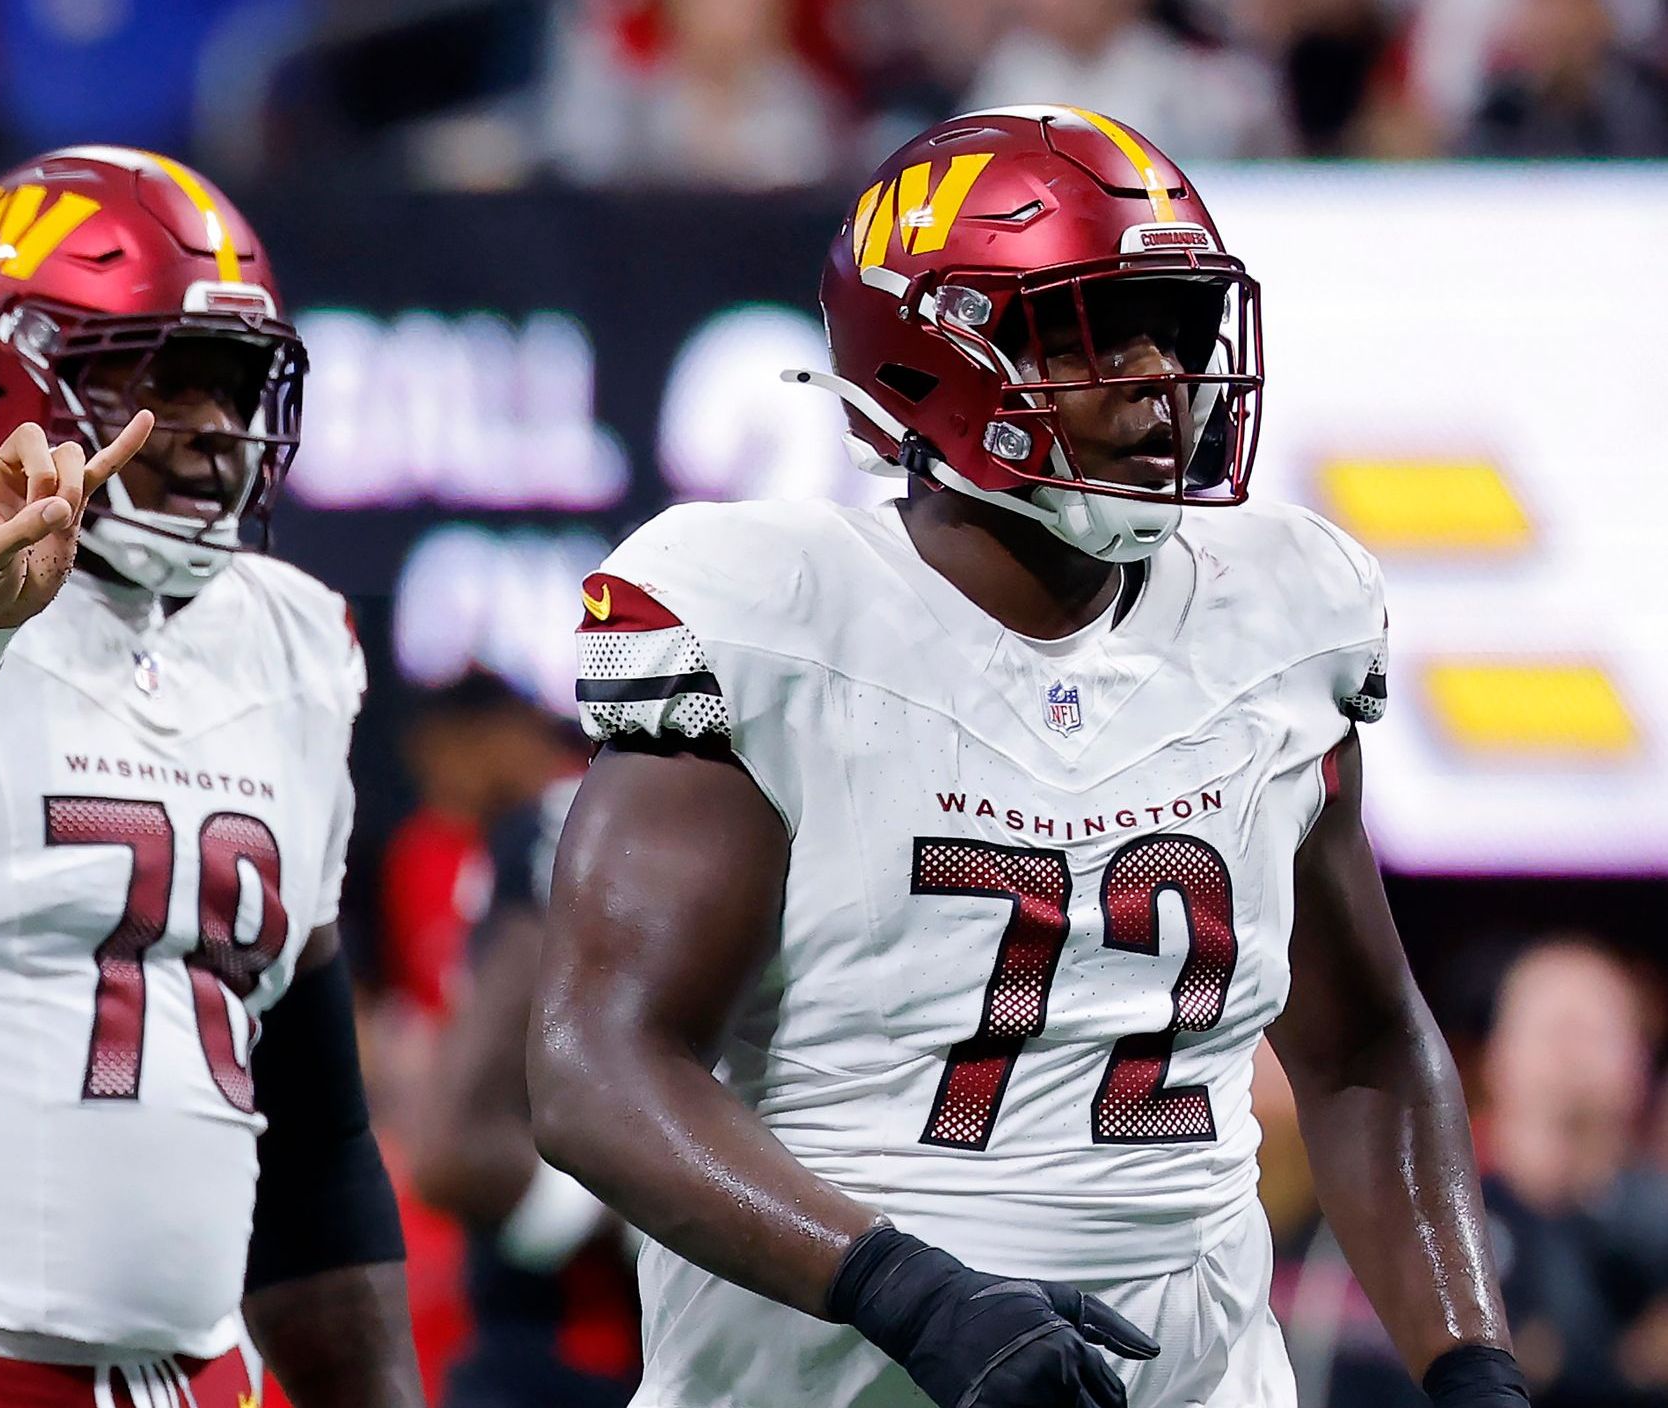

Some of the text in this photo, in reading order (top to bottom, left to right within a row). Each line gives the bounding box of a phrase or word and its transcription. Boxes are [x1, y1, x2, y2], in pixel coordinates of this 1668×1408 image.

[1049, 704, 1077, 726] NFL
[64, 752, 277, 801] WASHINGTON
[936, 790, 1224, 842] WASHINGTON
[43, 794, 289, 1115] 78
[910, 833, 1239, 1153] 72
